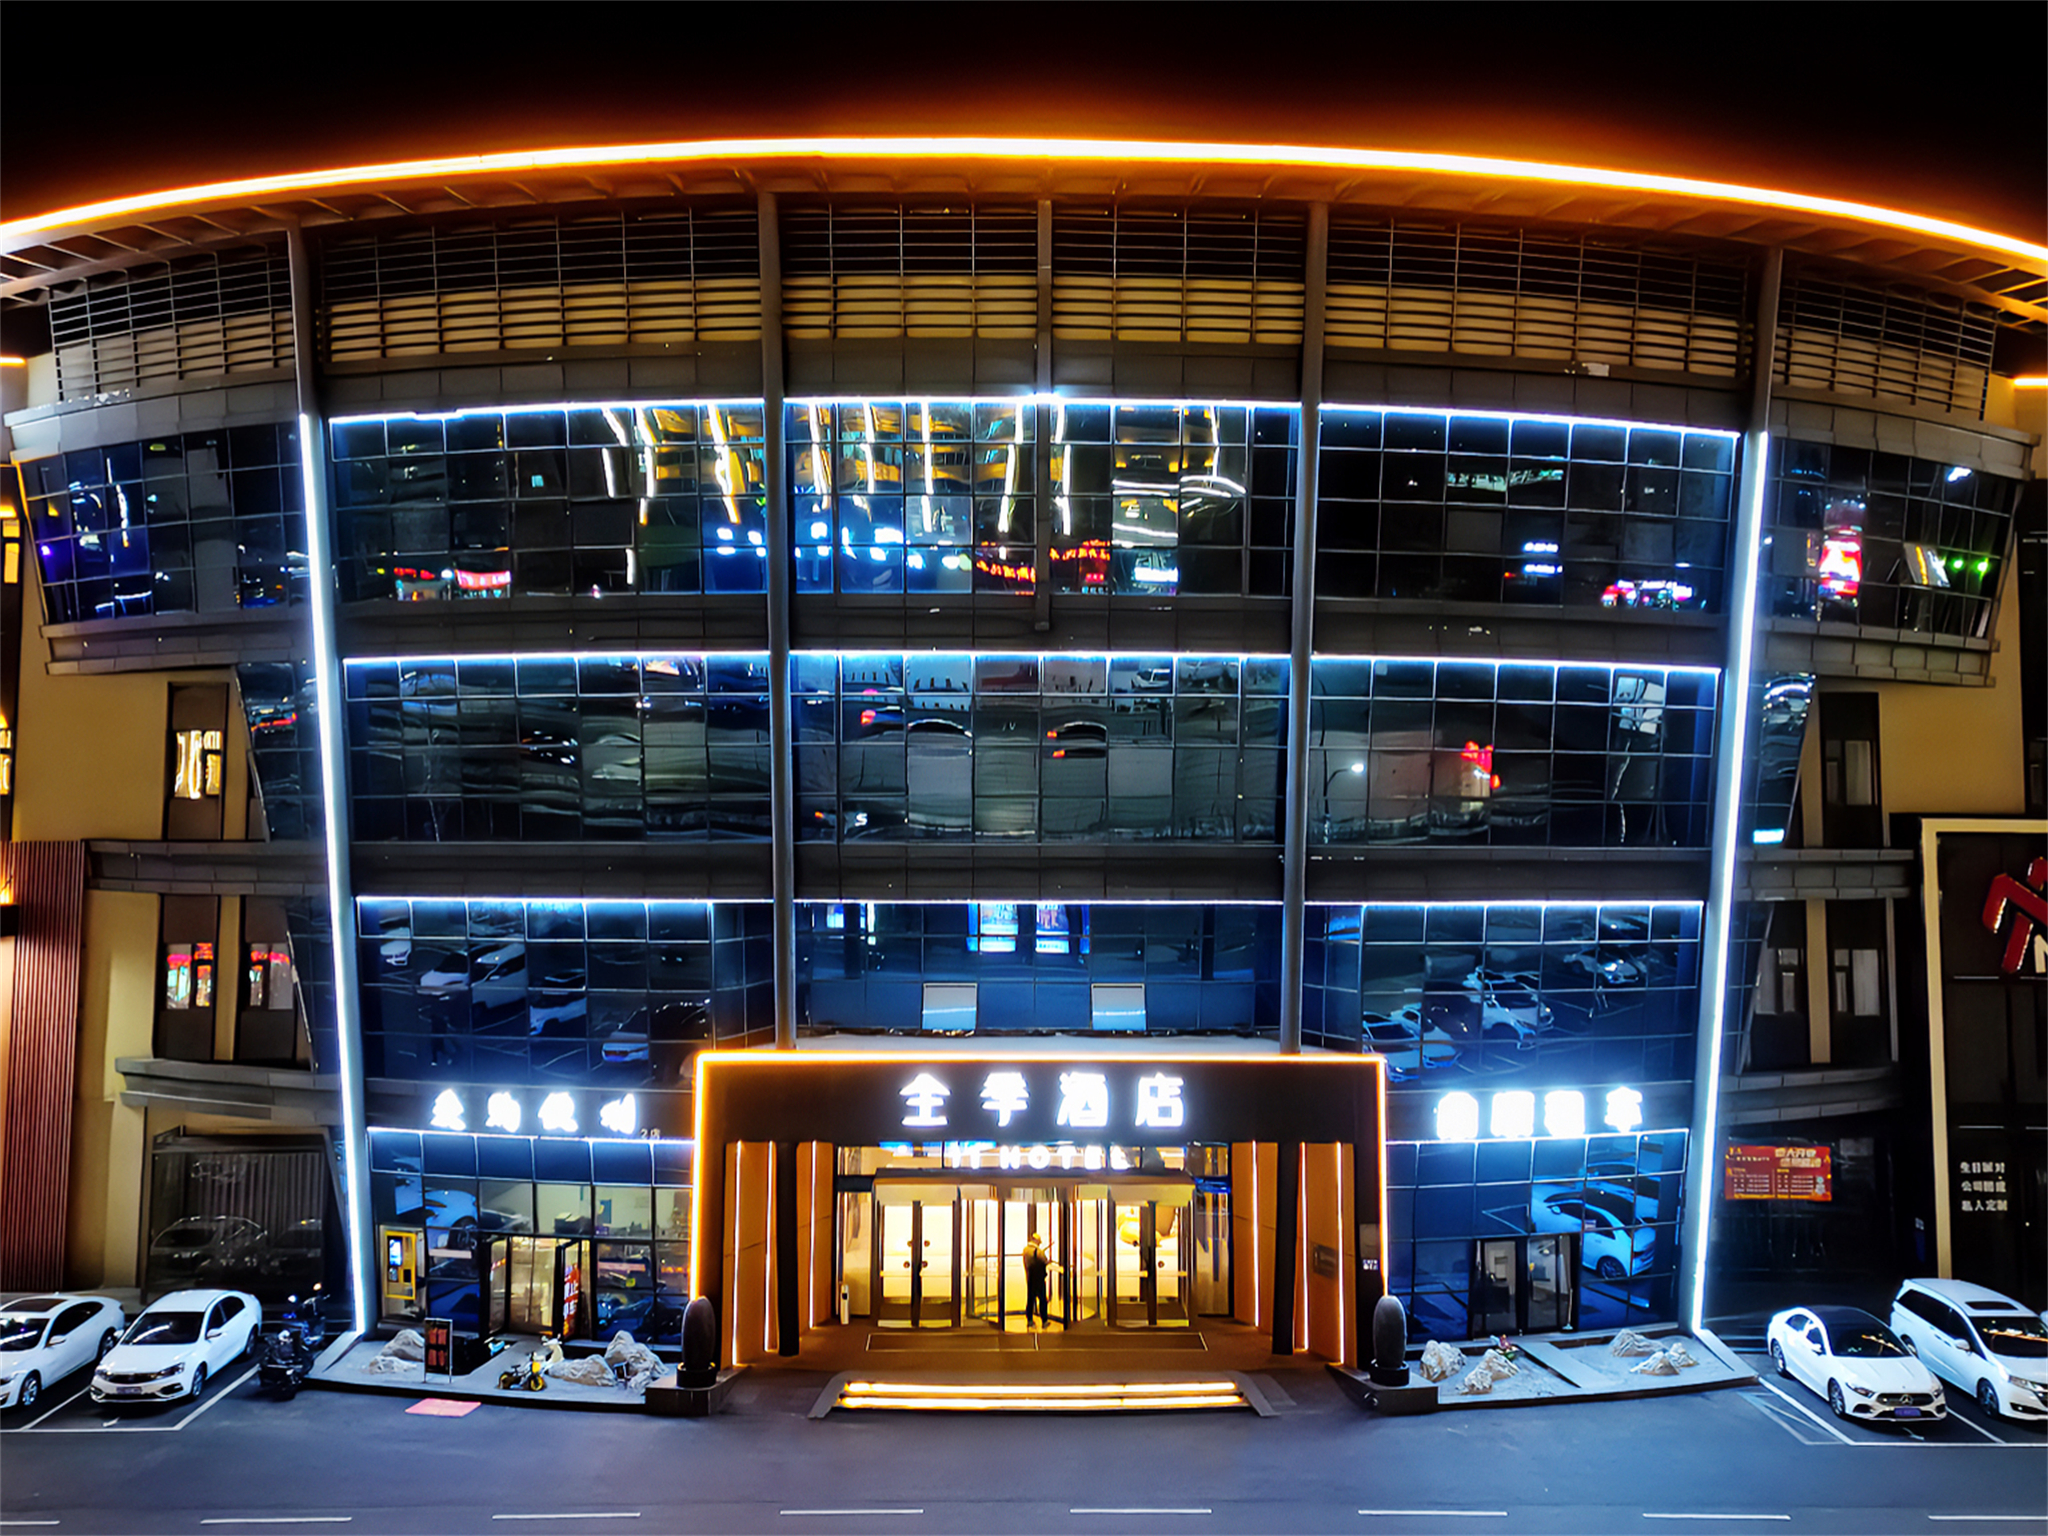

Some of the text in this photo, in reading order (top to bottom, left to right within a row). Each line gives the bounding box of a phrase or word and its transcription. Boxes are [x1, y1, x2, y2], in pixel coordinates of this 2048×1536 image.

[900, 1071, 1186, 1129] 全季酒店
[1000, 1144, 1131, 1170] HOTEL
